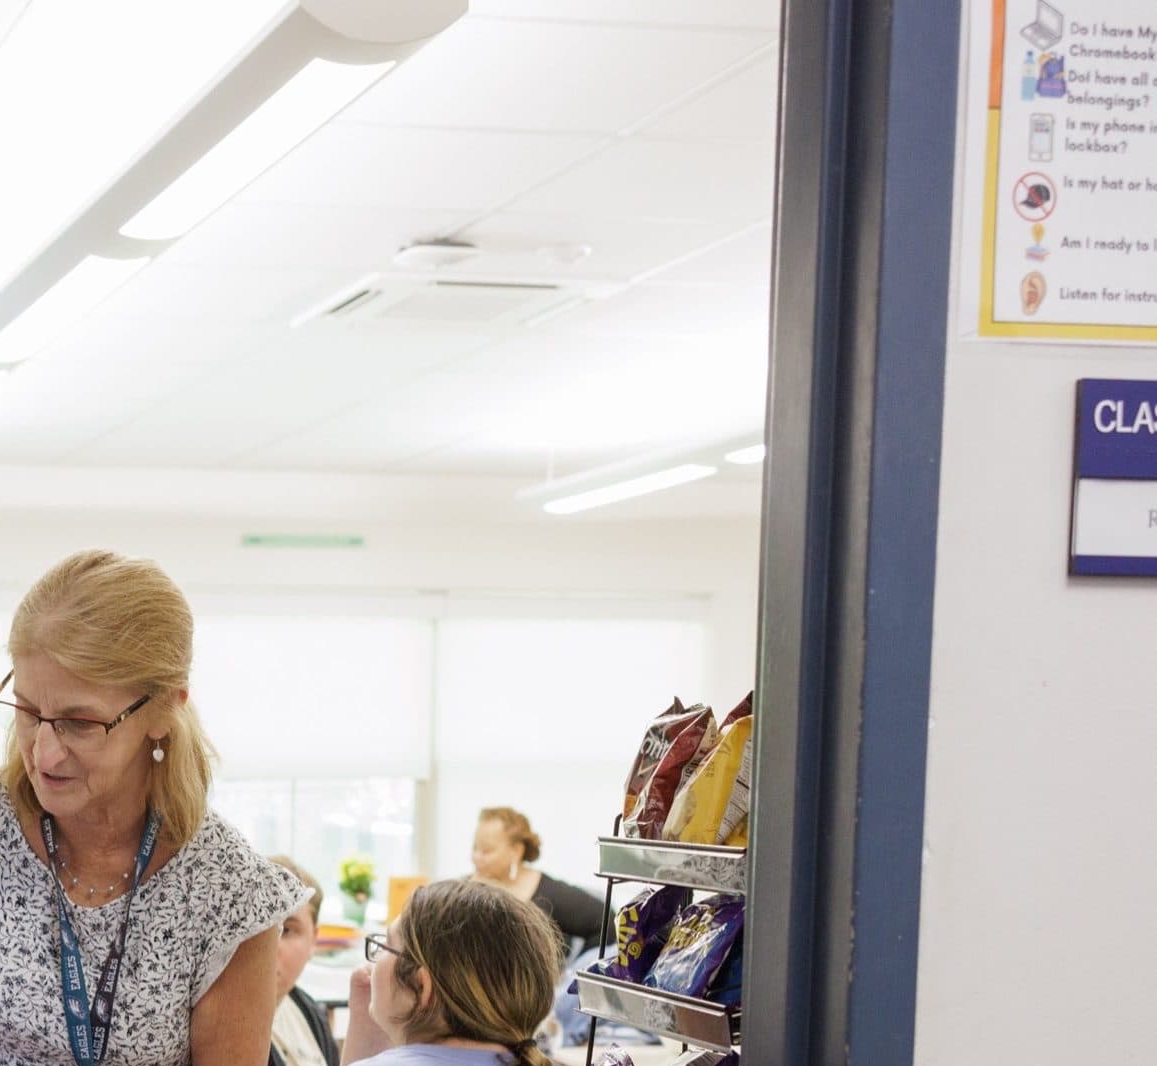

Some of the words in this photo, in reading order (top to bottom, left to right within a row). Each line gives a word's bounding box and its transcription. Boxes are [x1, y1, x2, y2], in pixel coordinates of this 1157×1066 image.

[1070, 22, 1089, 36] Do
[1102, 23, 1134, 38] have
[1138, 26, 1157, 44] My
[1069, 44, 1156, 60] Chromebook
[1095, 70, 1128, 86] have
[1131, 72, 1149, 86] all
[1067, 89, 1150, 112] belongings?
[1065, 116, 1076, 130] Is
[1080, 121, 1100, 136] my
[1104, 117, 1146, 137] phone
[1065, 137, 1128, 154] lockbox?
[1063, 175, 1074, 188] Is
[1077, 179, 1098, 194] my
[1101, 174, 1123, 190] hat
[1128, 181, 1142, 191] or
[1060, 235, 1082, 249] Am
[1094, 236, 1132, 255] ready
[1136, 240, 1149, 251] to
[1059, 286, 1098, 300] Listen
[1102, 286, 1121, 302] for
[1094, 399, 1157, 434] CLA
[67, 955, 81, 991] EAGLES
[104, 958, 119, 993] EAGLES
[76, 1024, 90, 1059] EAGLES
[93, 1026, 106, 1061] EAGLES
